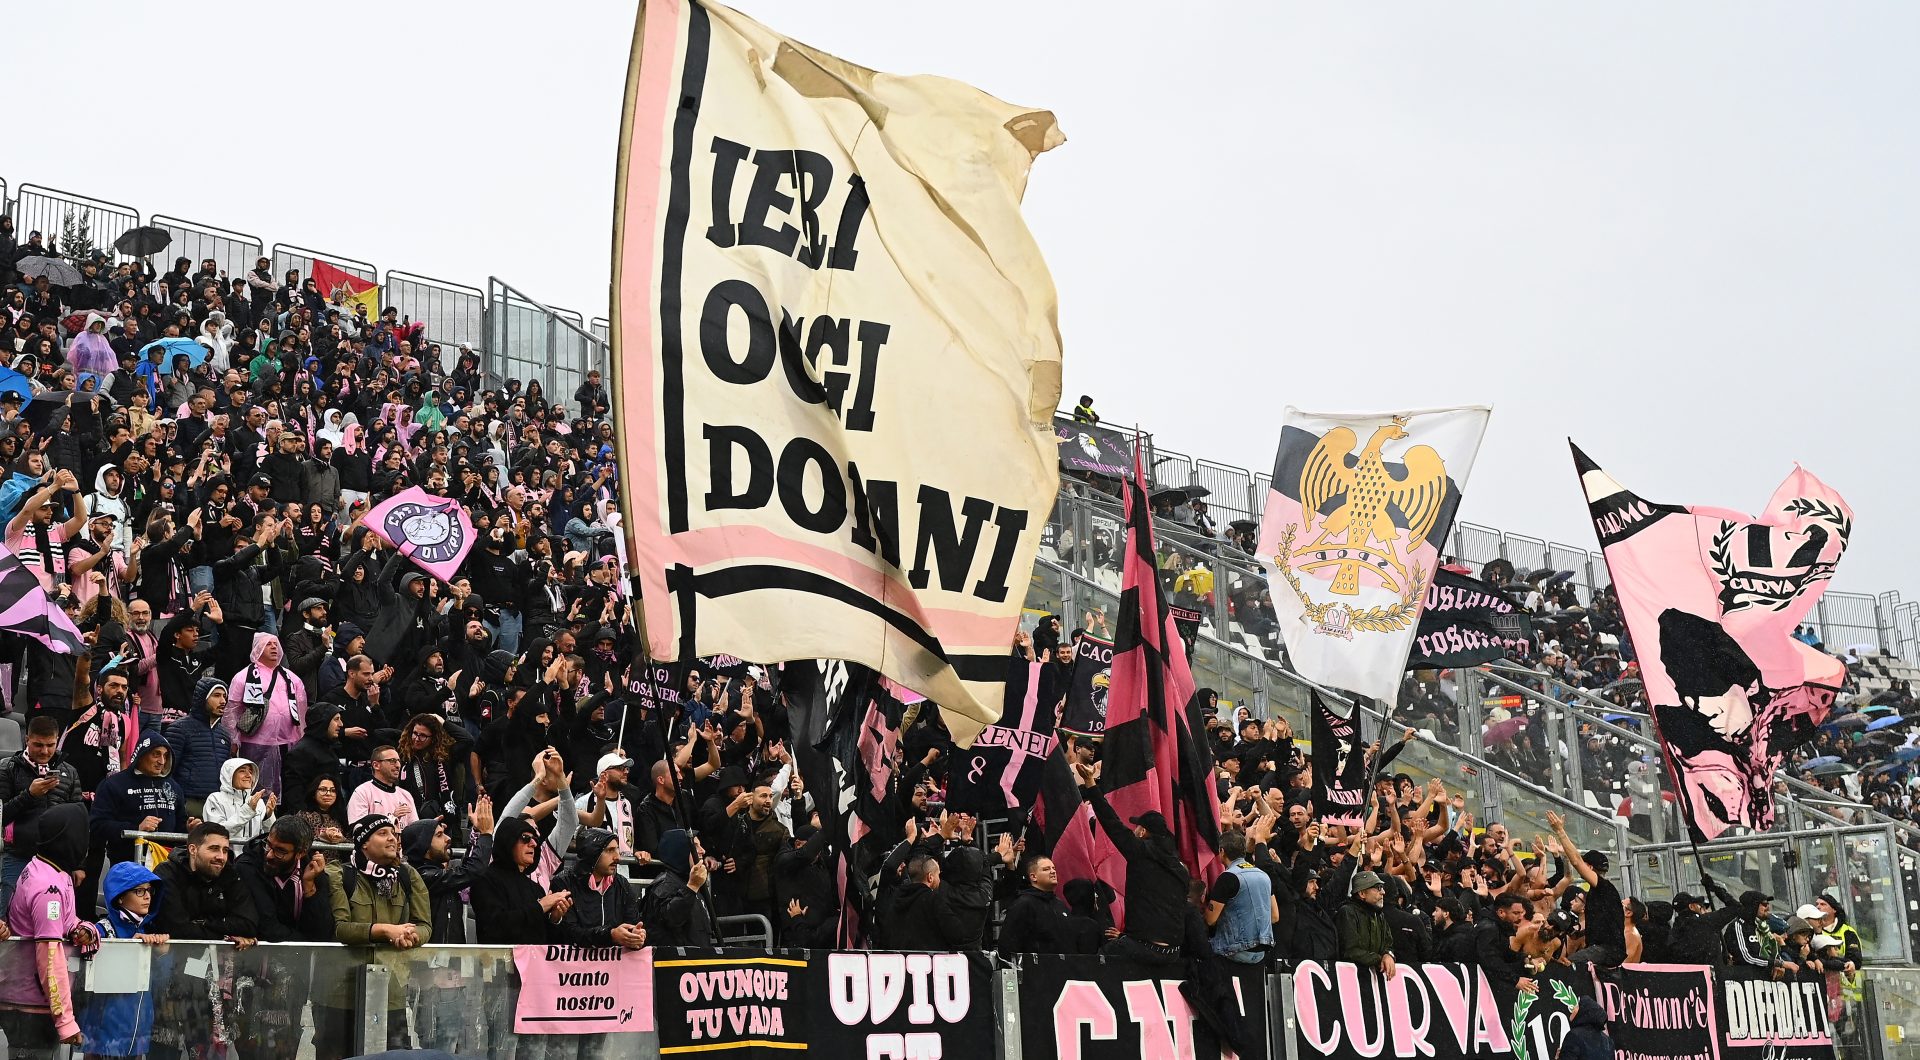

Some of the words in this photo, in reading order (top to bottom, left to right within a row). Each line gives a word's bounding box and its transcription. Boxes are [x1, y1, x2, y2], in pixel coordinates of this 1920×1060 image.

[705, 136, 870, 271] IERI
[700, 279, 891, 432] OGGI
[1740, 524, 1829, 569] 12
[1729, 577, 1796, 595] CURVA
[1079, 641, 1113, 664] CAC
[558, 970, 610, 987] vanto
[679, 968, 789, 1003] OVUNQUE
[828, 953, 971, 1026] ODIO
[556, 994, 615, 1011] nostro
[1293, 959, 1512, 1059] CURVA
[1654, 997, 1683, 1030] non
[1724, 979, 1832, 1040] DIFFIDATI
[687, 1007, 723, 1040] TU
[727, 1005, 784, 1040] VADA
